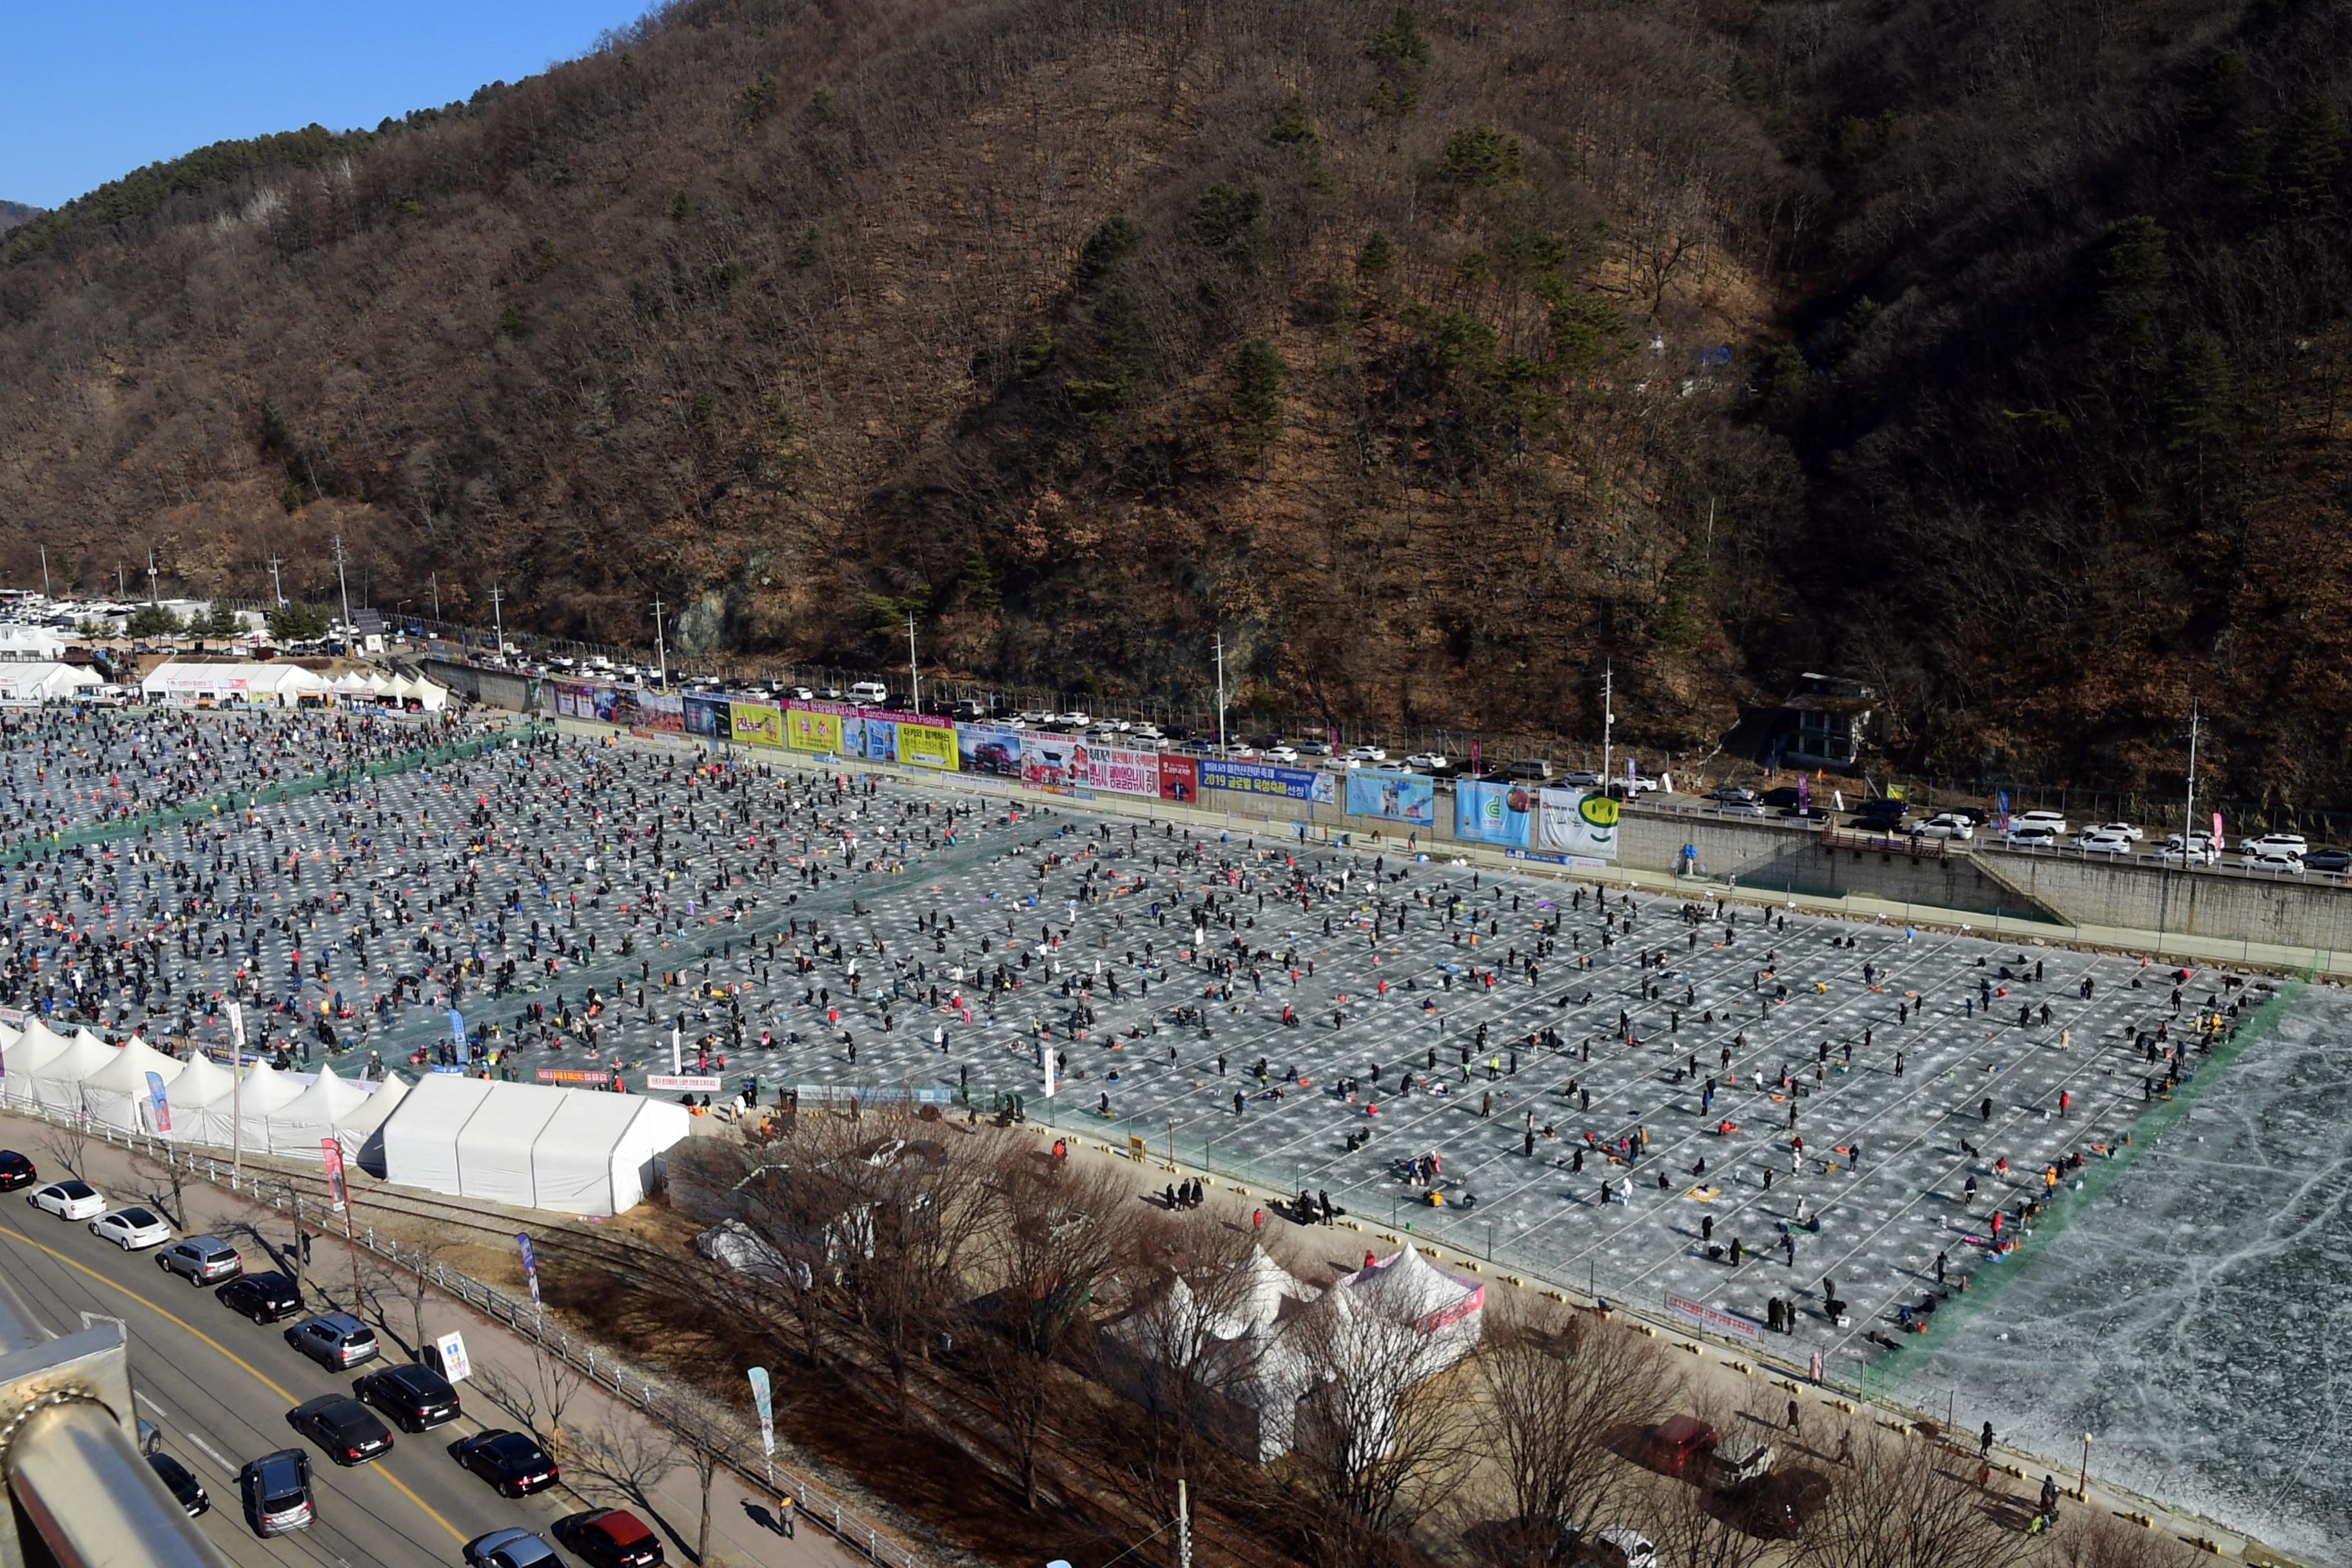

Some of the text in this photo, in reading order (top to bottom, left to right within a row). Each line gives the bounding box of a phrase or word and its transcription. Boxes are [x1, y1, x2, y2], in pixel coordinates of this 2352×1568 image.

[789, 699, 808, 712] 산천어
[907, 713, 917, 723] Ice
[919, 715, 945, 727] Fishing
[903, 727, 922, 738] 타키와
[925, 729, 949, 742] 함께하는
[1088, 747, 1110, 763] 축제기간
[1112, 750, 1133, 765] 화천에서
[1135, 753, 1157, 768] 숙박하면
[1204, 761, 1226, 772] 얼음나라
[1204, 773, 1304, 798] 2019 글로벌 육성축제 선정
